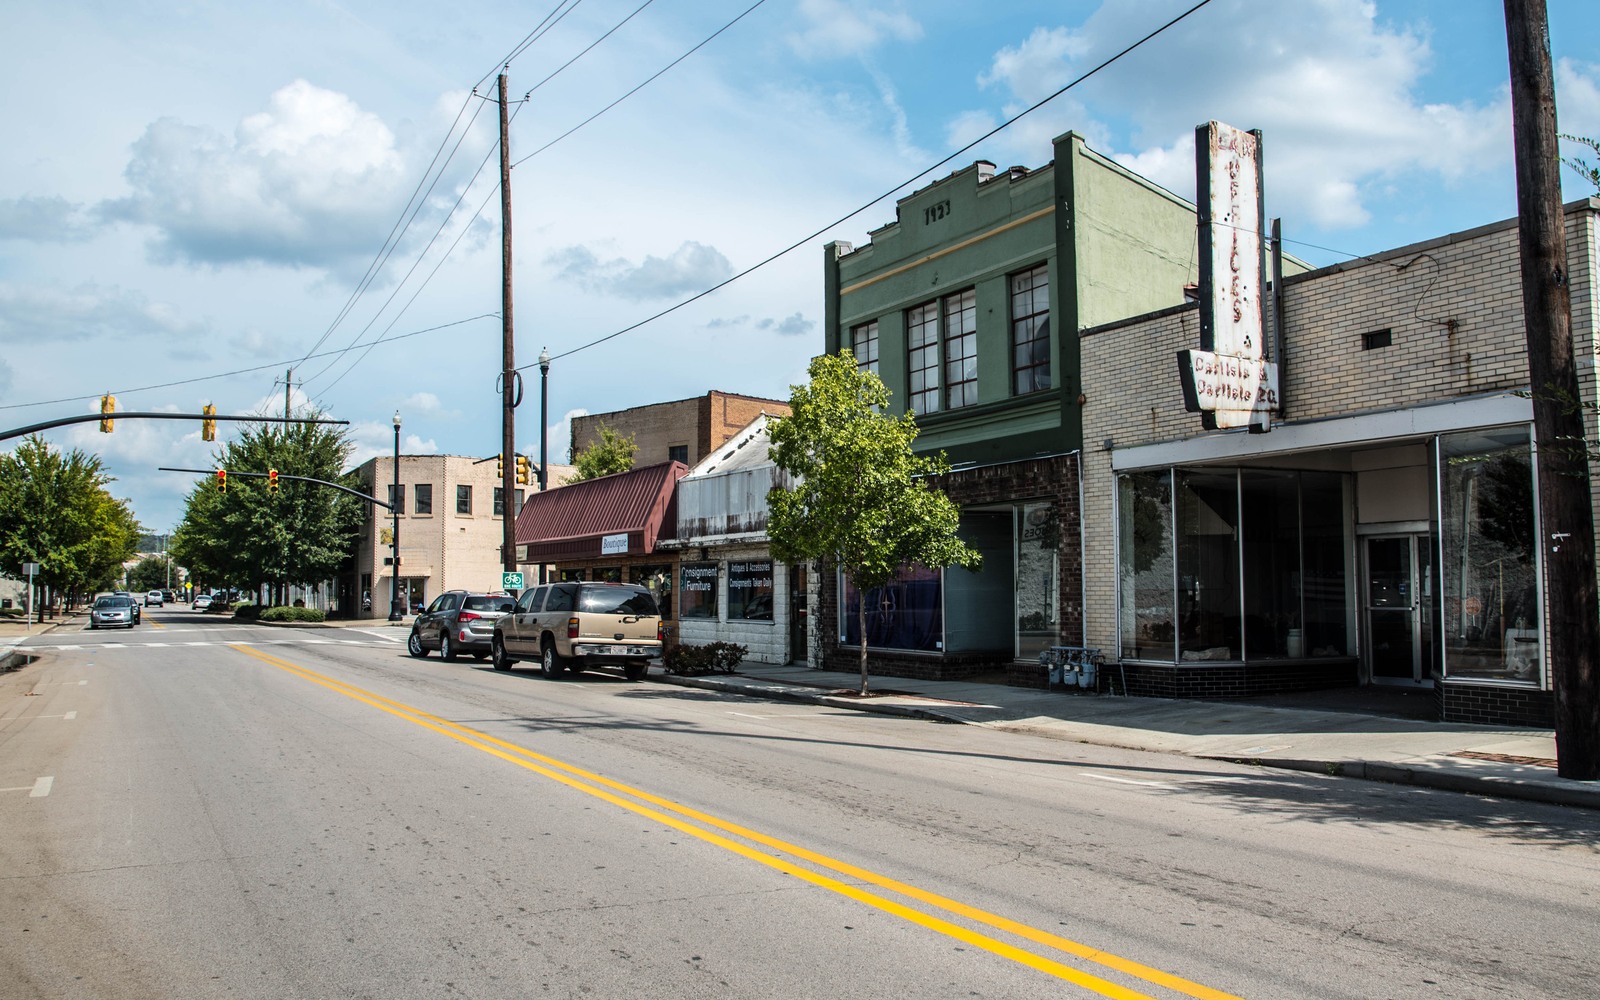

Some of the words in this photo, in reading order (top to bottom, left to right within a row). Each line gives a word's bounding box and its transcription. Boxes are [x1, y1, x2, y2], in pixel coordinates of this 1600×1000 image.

[923, 199, 951, 226] 1923
[603, 537, 627, 552] Boutique
[681, 566, 717, 579] Consignment
[731, 563, 745, 573] Antiques
[749, 562, 770, 572] Accessories
[686, 581, 711, 591] Furniture
[730, 578, 752, 589] Consignments
[752, 577, 763, 587] Taken
[763, 577, 772, 589] Daily
